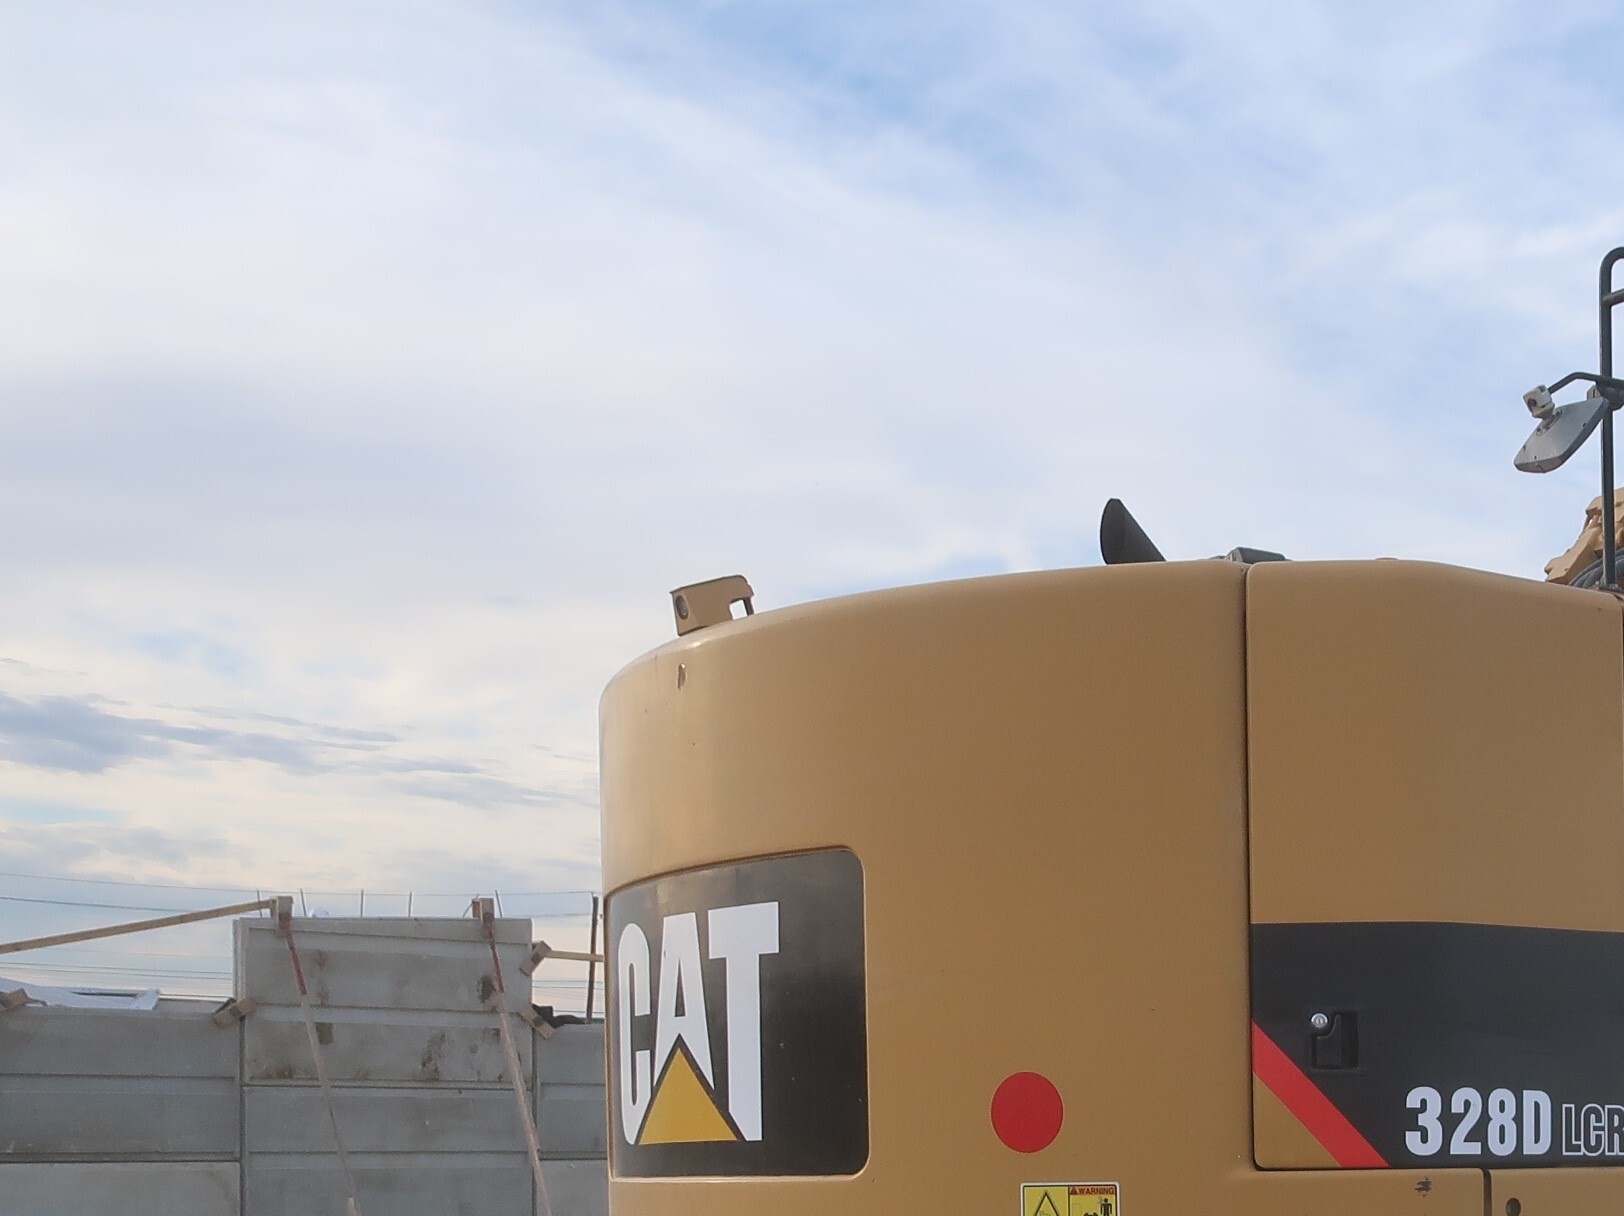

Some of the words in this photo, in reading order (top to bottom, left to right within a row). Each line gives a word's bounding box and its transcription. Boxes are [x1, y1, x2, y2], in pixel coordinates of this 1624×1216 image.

[616, 901, 780, 1146] CAT
[1405, 1086, 1552, 1156] 328D
[1079, 1187, 1115, 1195] WARNING
